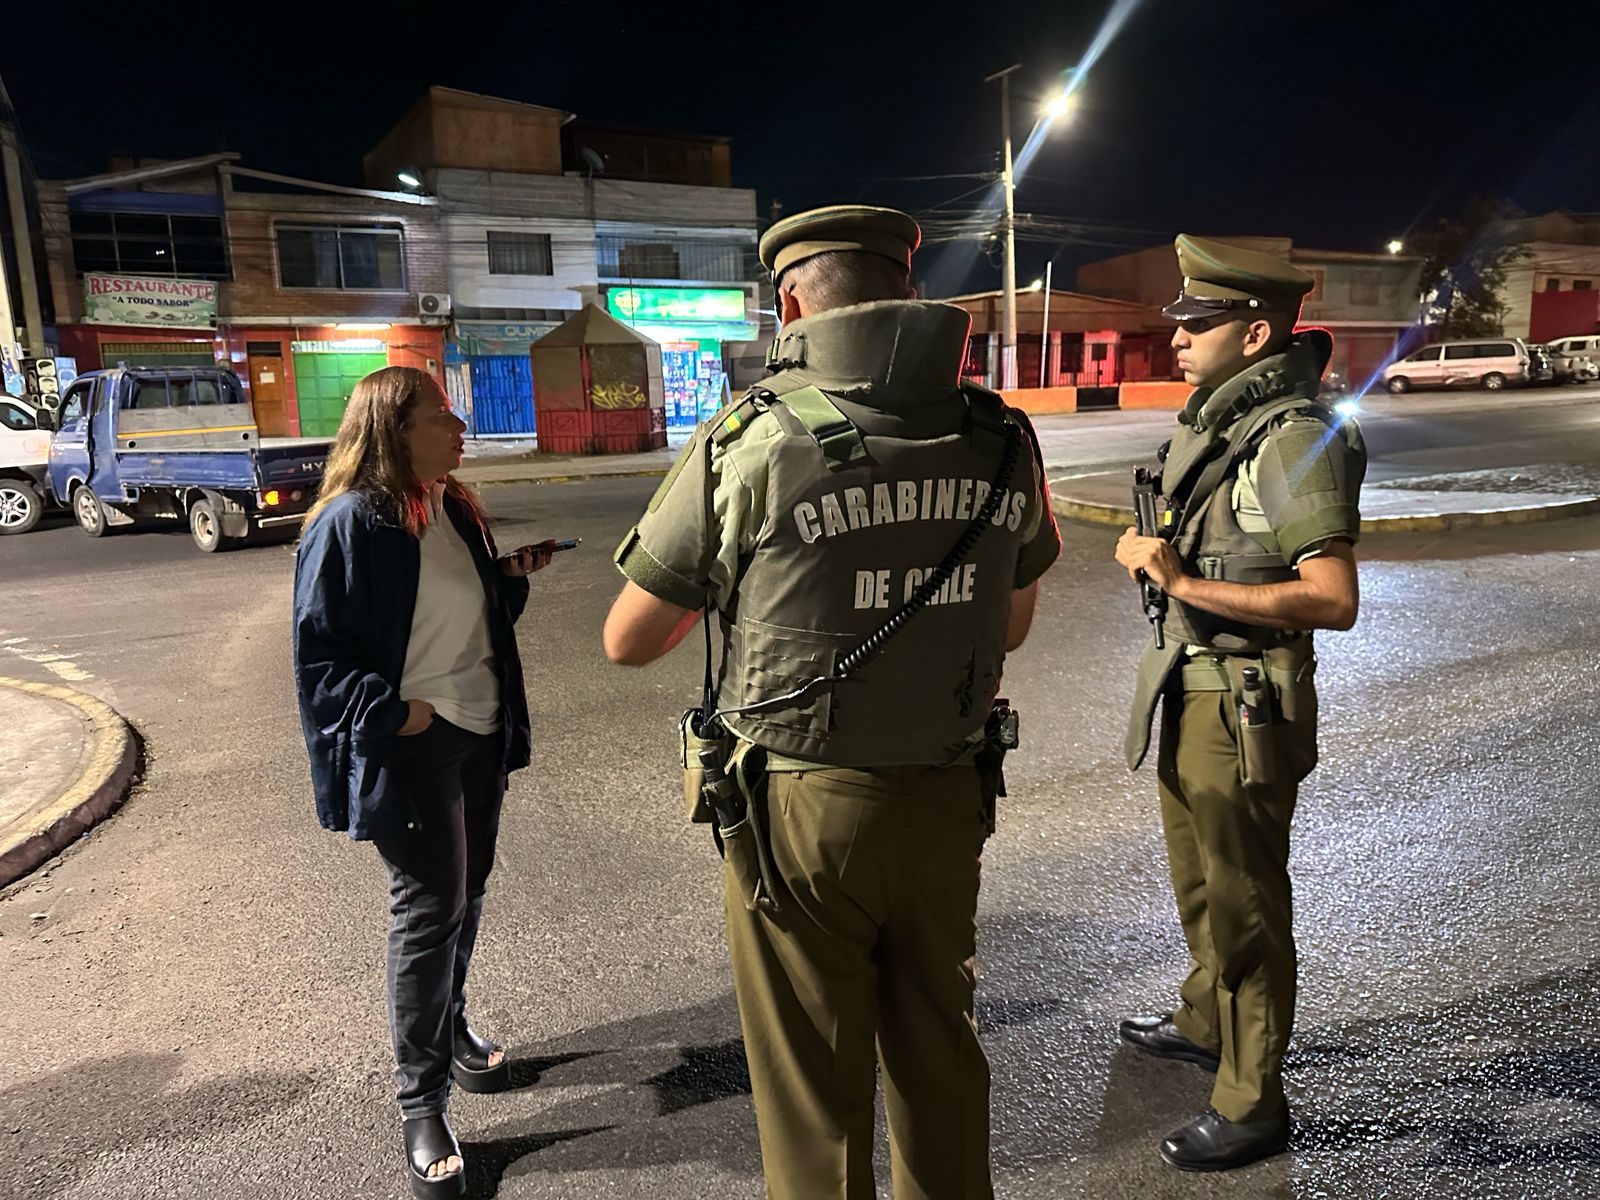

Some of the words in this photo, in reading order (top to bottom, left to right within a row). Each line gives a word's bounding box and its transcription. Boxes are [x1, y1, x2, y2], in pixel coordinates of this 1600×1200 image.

[89, 277, 215, 302] RESTAURANTE
[127, 297, 154, 305] TODO
[156, 299, 194, 307] SABOR"
[302, 461, 324, 472] HY
[793, 478, 1027, 544] CARABINEROS
[854, 570, 890, 609] DE
